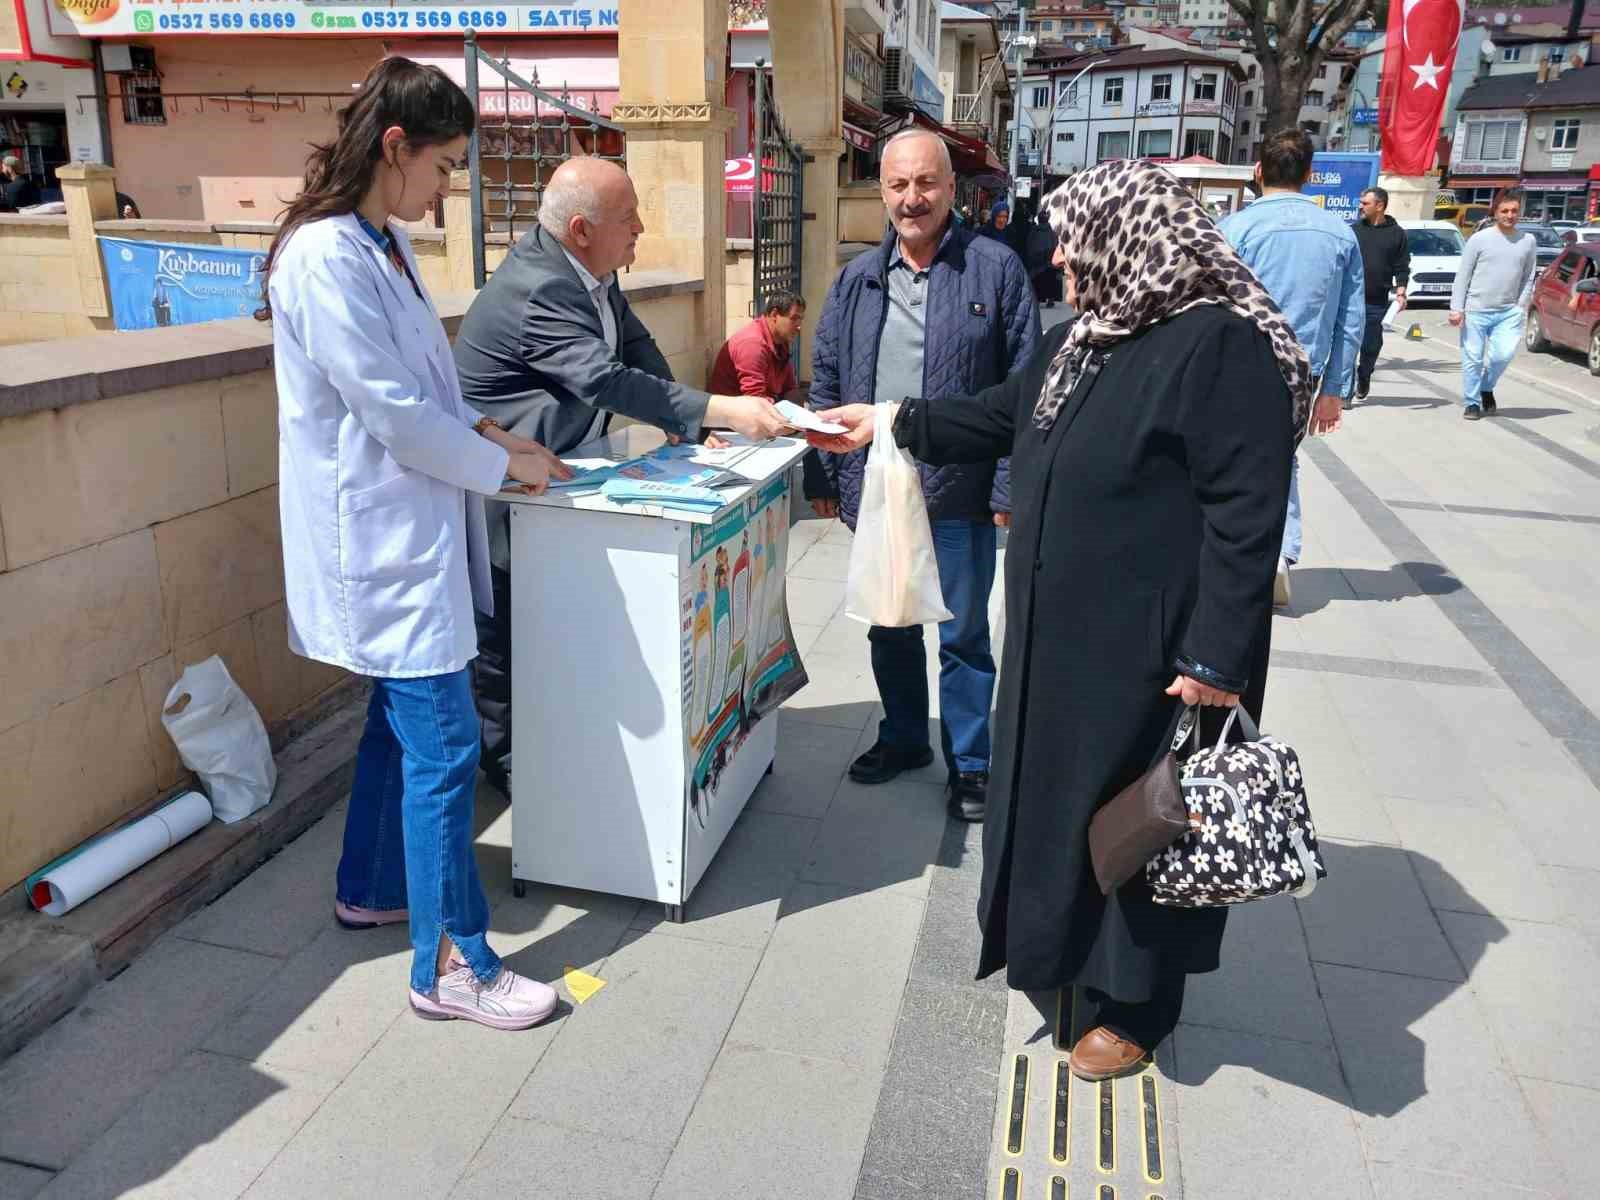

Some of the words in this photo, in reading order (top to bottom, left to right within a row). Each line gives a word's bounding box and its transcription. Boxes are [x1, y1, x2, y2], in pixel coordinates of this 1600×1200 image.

[159, 13, 203, 29] 0537
[209, 12, 243, 29] 569
[249, 12, 296, 28] 6869
[311, 12, 357, 28] Gsm
[362, 11, 409, 28] 0537
[415, 11, 451, 27] 569
[458, 11, 508, 27] 6869
[528, 9, 593, 31] SATIŞ
